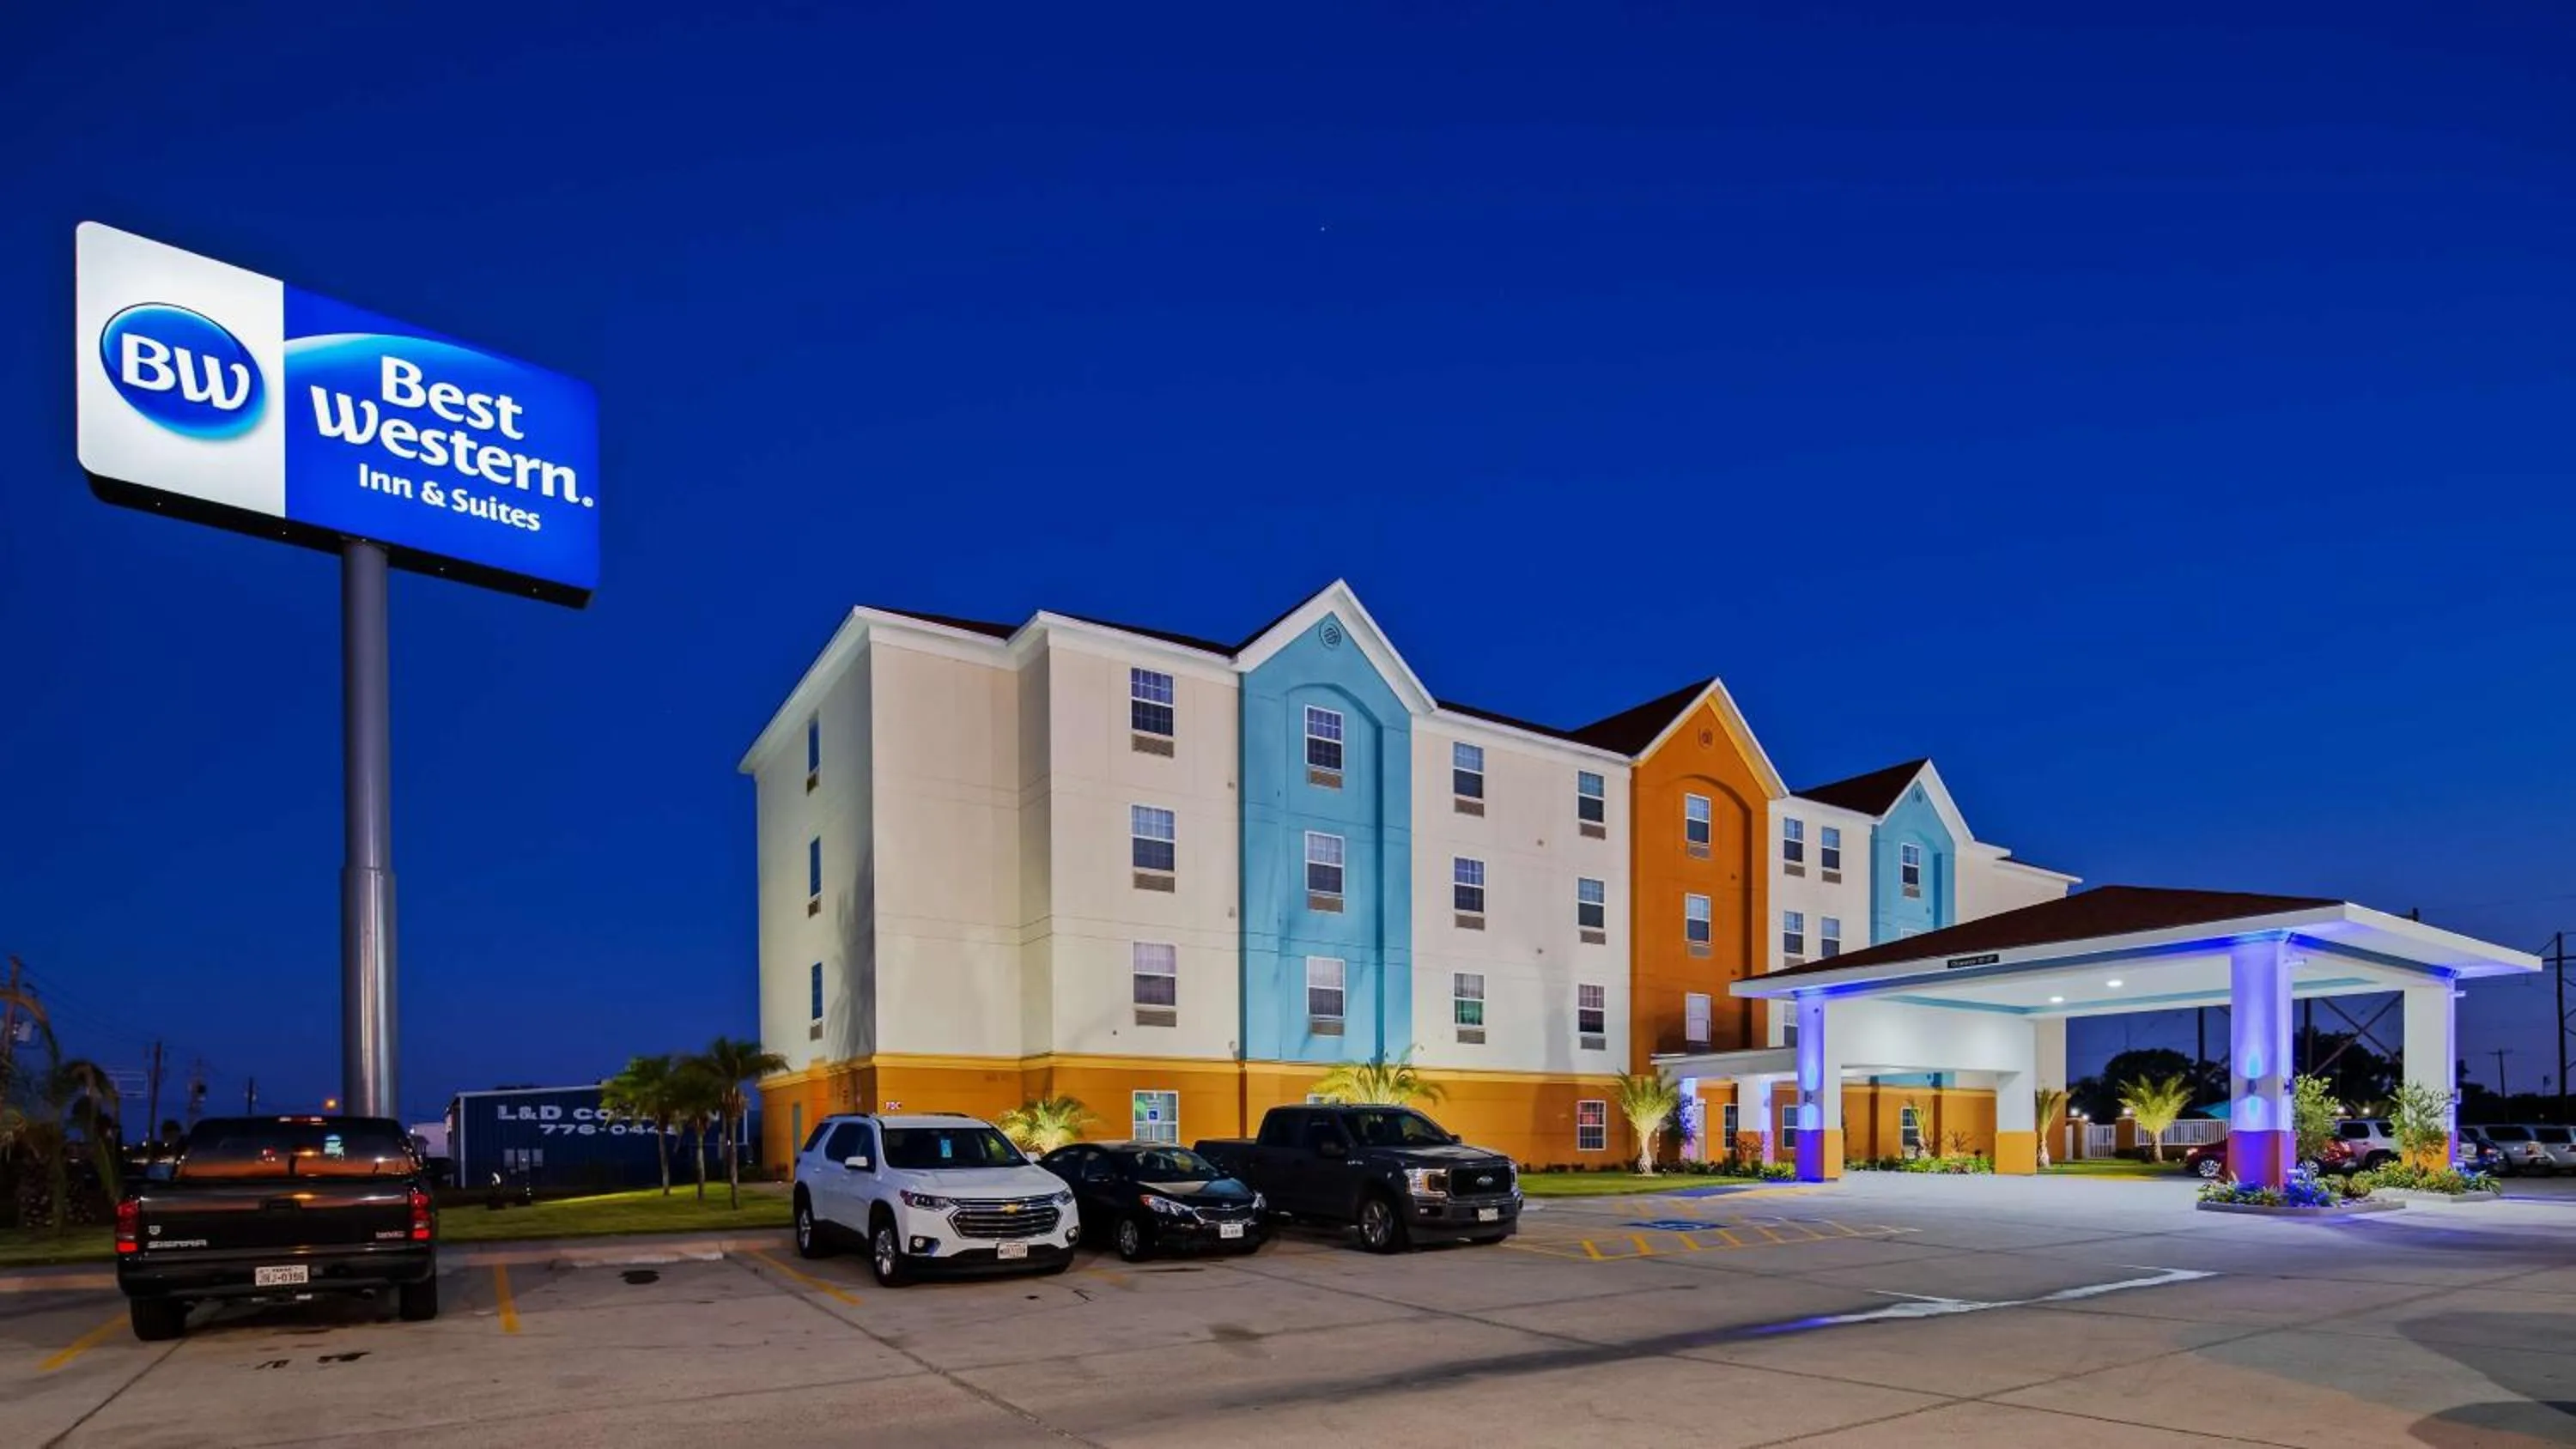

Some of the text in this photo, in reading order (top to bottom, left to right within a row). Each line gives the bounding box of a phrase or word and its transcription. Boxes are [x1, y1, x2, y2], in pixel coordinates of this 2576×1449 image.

[122, 332, 250, 411] BW
[381, 355, 525, 440] Best
[359, 462, 541, 531] Inn & Suites
[498, 1105, 562, 1121] L&D
